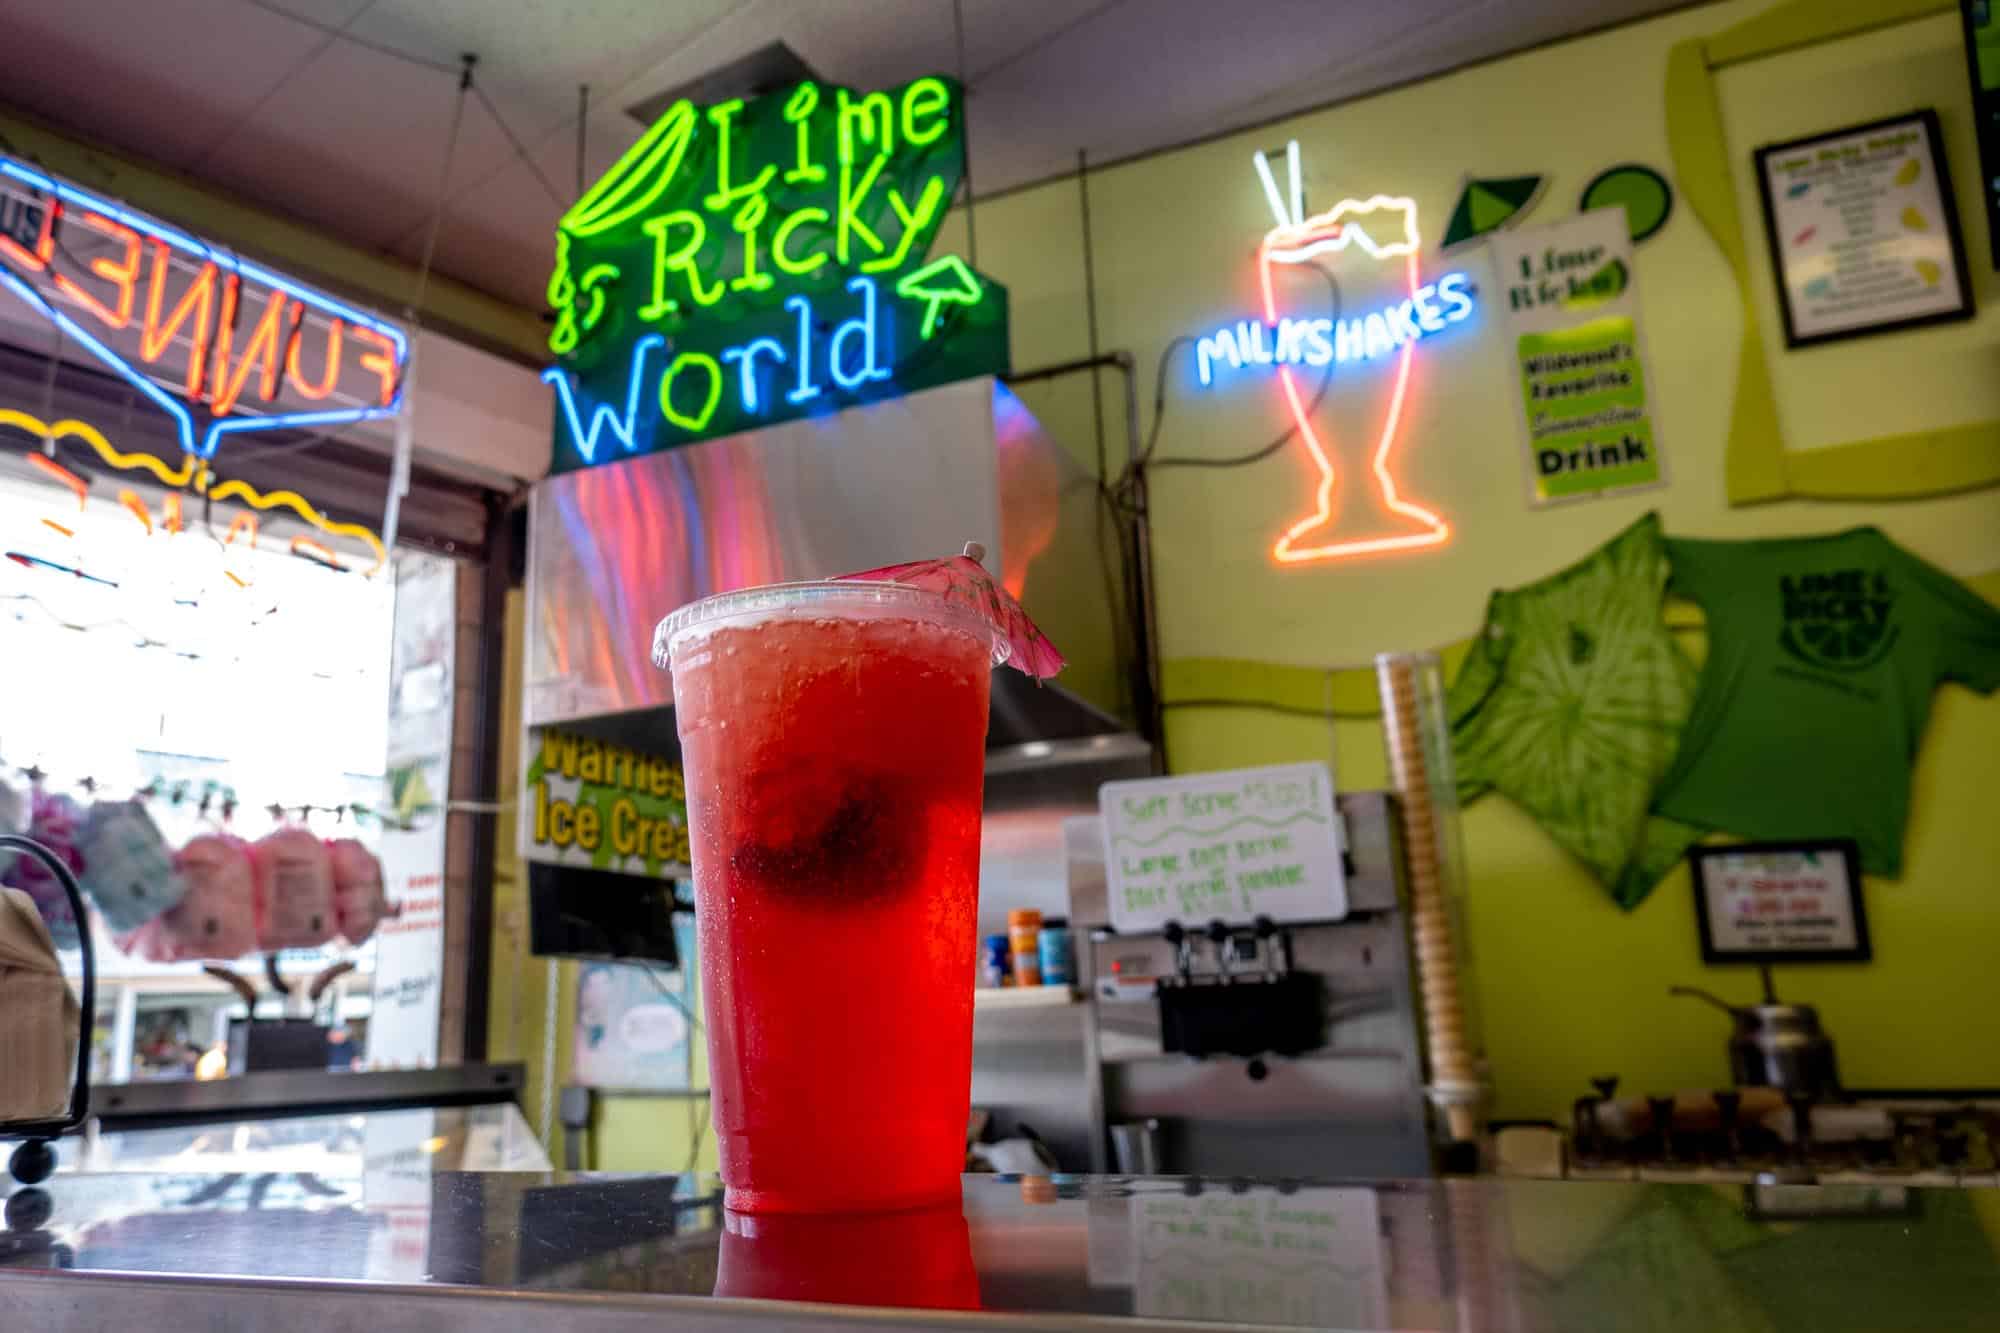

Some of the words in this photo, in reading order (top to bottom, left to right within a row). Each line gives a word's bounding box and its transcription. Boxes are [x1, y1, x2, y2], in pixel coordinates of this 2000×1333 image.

[705, 77, 949, 211] Lime
[638, 154, 944, 321] Ricky
[1519, 244, 1604, 280] Lime
[540, 275, 892, 464] World
[1197, 271, 1473, 387] MILKSHAKES
[1531, 369, 1631, 400] Favorite
[1537, 434, 1649, 476] Drink
[533, 777, 600, 851] Ice
[610, 795, 692, 865] Crea
